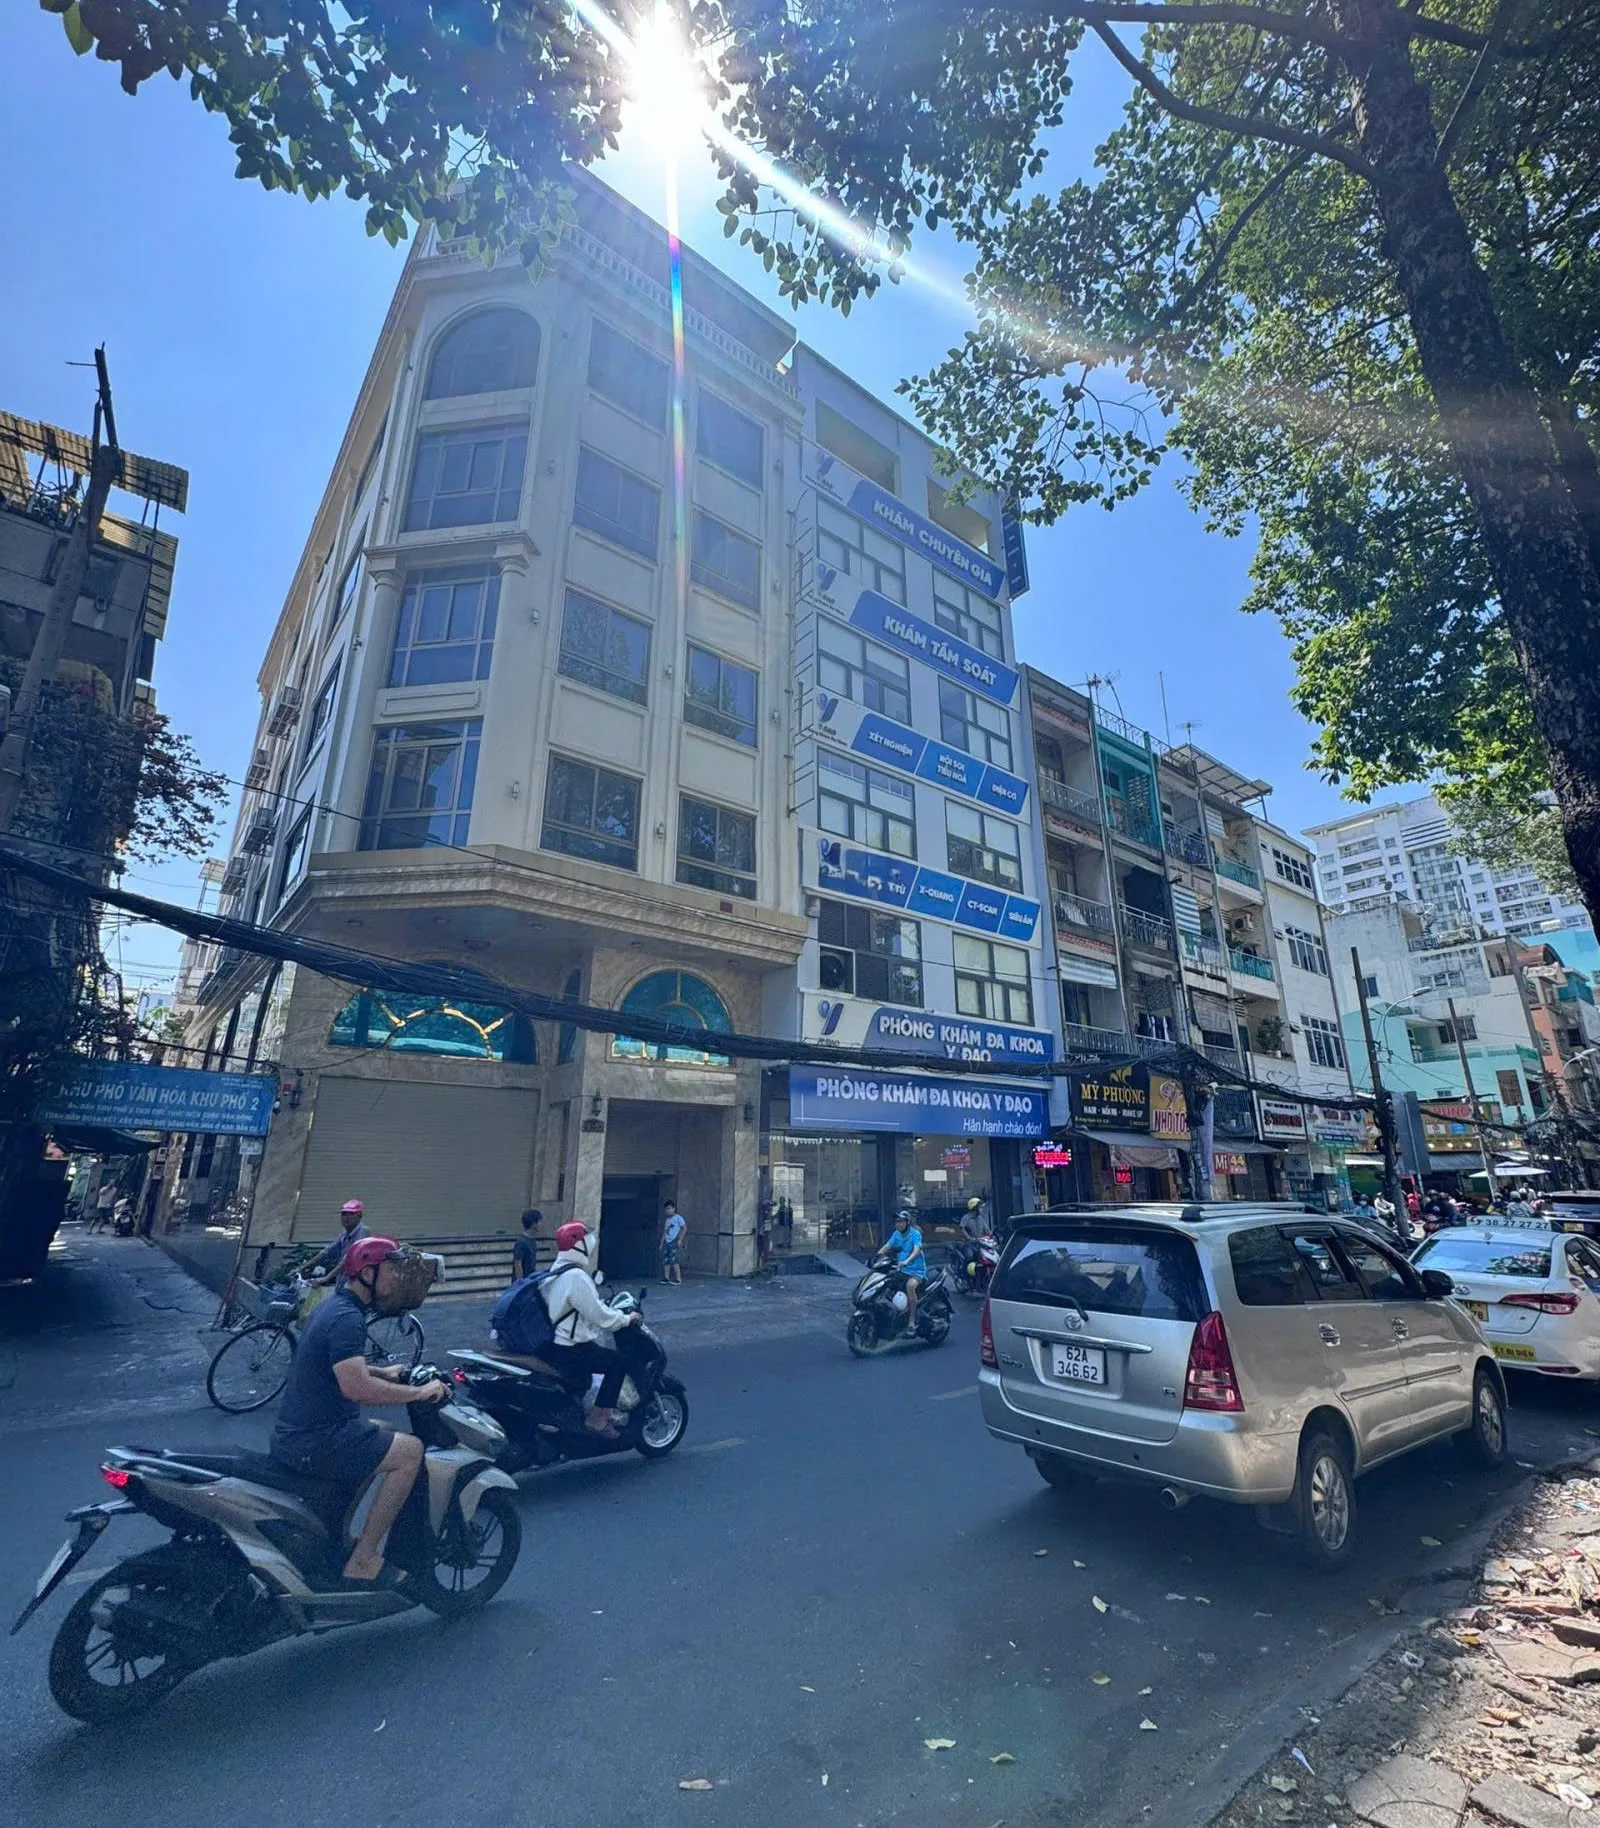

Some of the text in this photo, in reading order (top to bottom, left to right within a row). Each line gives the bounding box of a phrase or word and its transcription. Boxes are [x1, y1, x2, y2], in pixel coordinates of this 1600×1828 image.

[873, 499, 914, 535] KHÁM
[919, 530, 969, 570] CHUYÊN
[970, 563, 992, 587] GIA
[884, 615, 927, 650] KHÁM
[963, 658, 997, 686] SOÁT
[967, 900, 998, 915] CT-SCAN
[880, 1014, 1045, 1055] PHÒNG KHÁM ĐA KHOA
[946, 1045, 956, 1059] Y
[94, 1080, 129, 1099] PHỐ
[130, 1083, 157, 1102] VĂN
[190, 1091, 219, 1107] KHU
[220, 1091, 250, 1110] PHỐ
[250, 1097, 259, 1110] 2
[816, 1075, 1032, 1117] PHÒNG KHÁM ĐA KHOA Y ĐẠO
[1103, 1086, 1145, 1106] PHƯỢNG
[963, 1117, 980, 1132] Hân
[1005, 1119, 1023, 1134] chào
[1503, 1219, 1515, 1228] 27
[1519, 1220, 1531, 1228] 27
[1535, 1221, 1548, 1230] 27
[1066, 1346, 1088, 1363] 62A
[1058, 1361, 1098, 1381] 346.62
